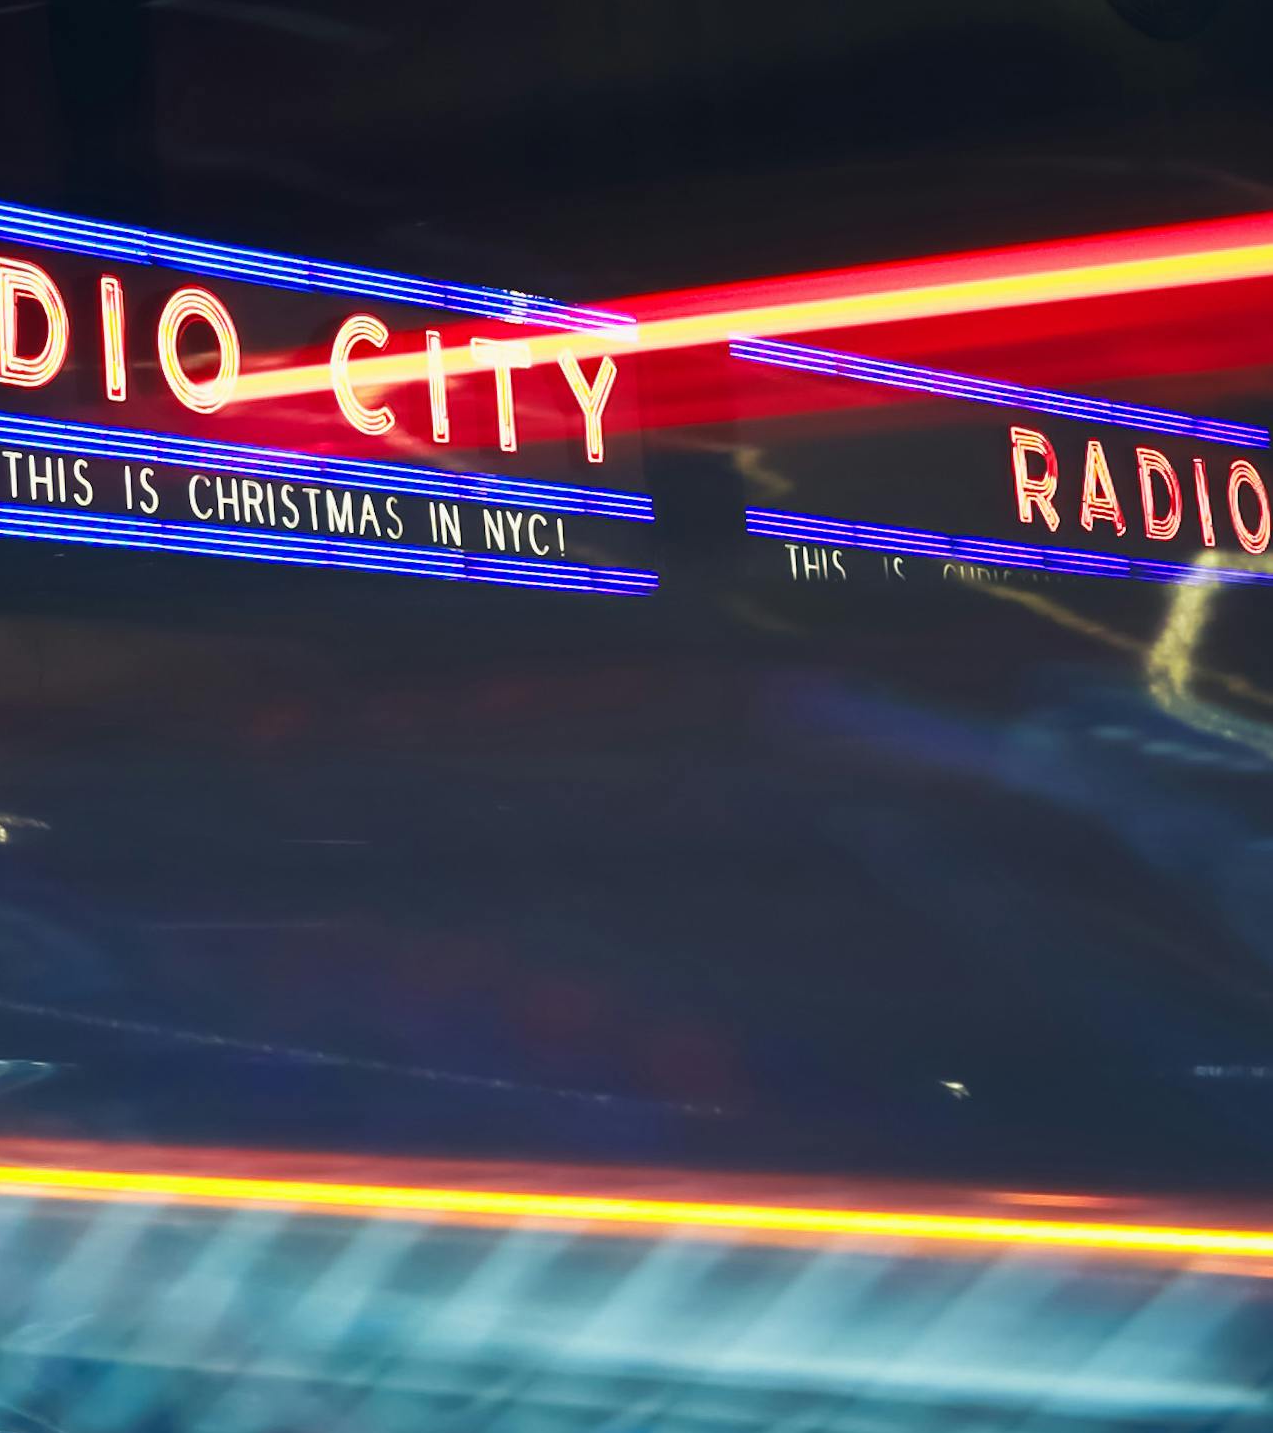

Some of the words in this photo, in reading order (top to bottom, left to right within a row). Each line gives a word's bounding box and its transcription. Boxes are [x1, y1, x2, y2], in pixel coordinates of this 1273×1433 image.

[329, 312, 619, 464] CITY
[3, 450, 94, 507] THIS
[124, 464, 160, 516] IS
[188, 474, 405, 542] CHRISTMAS
[429, 501, 464, 549] IN
[482, 510, 568, 559] NYC!
[1009, 425, 1272, 555] RADIO
